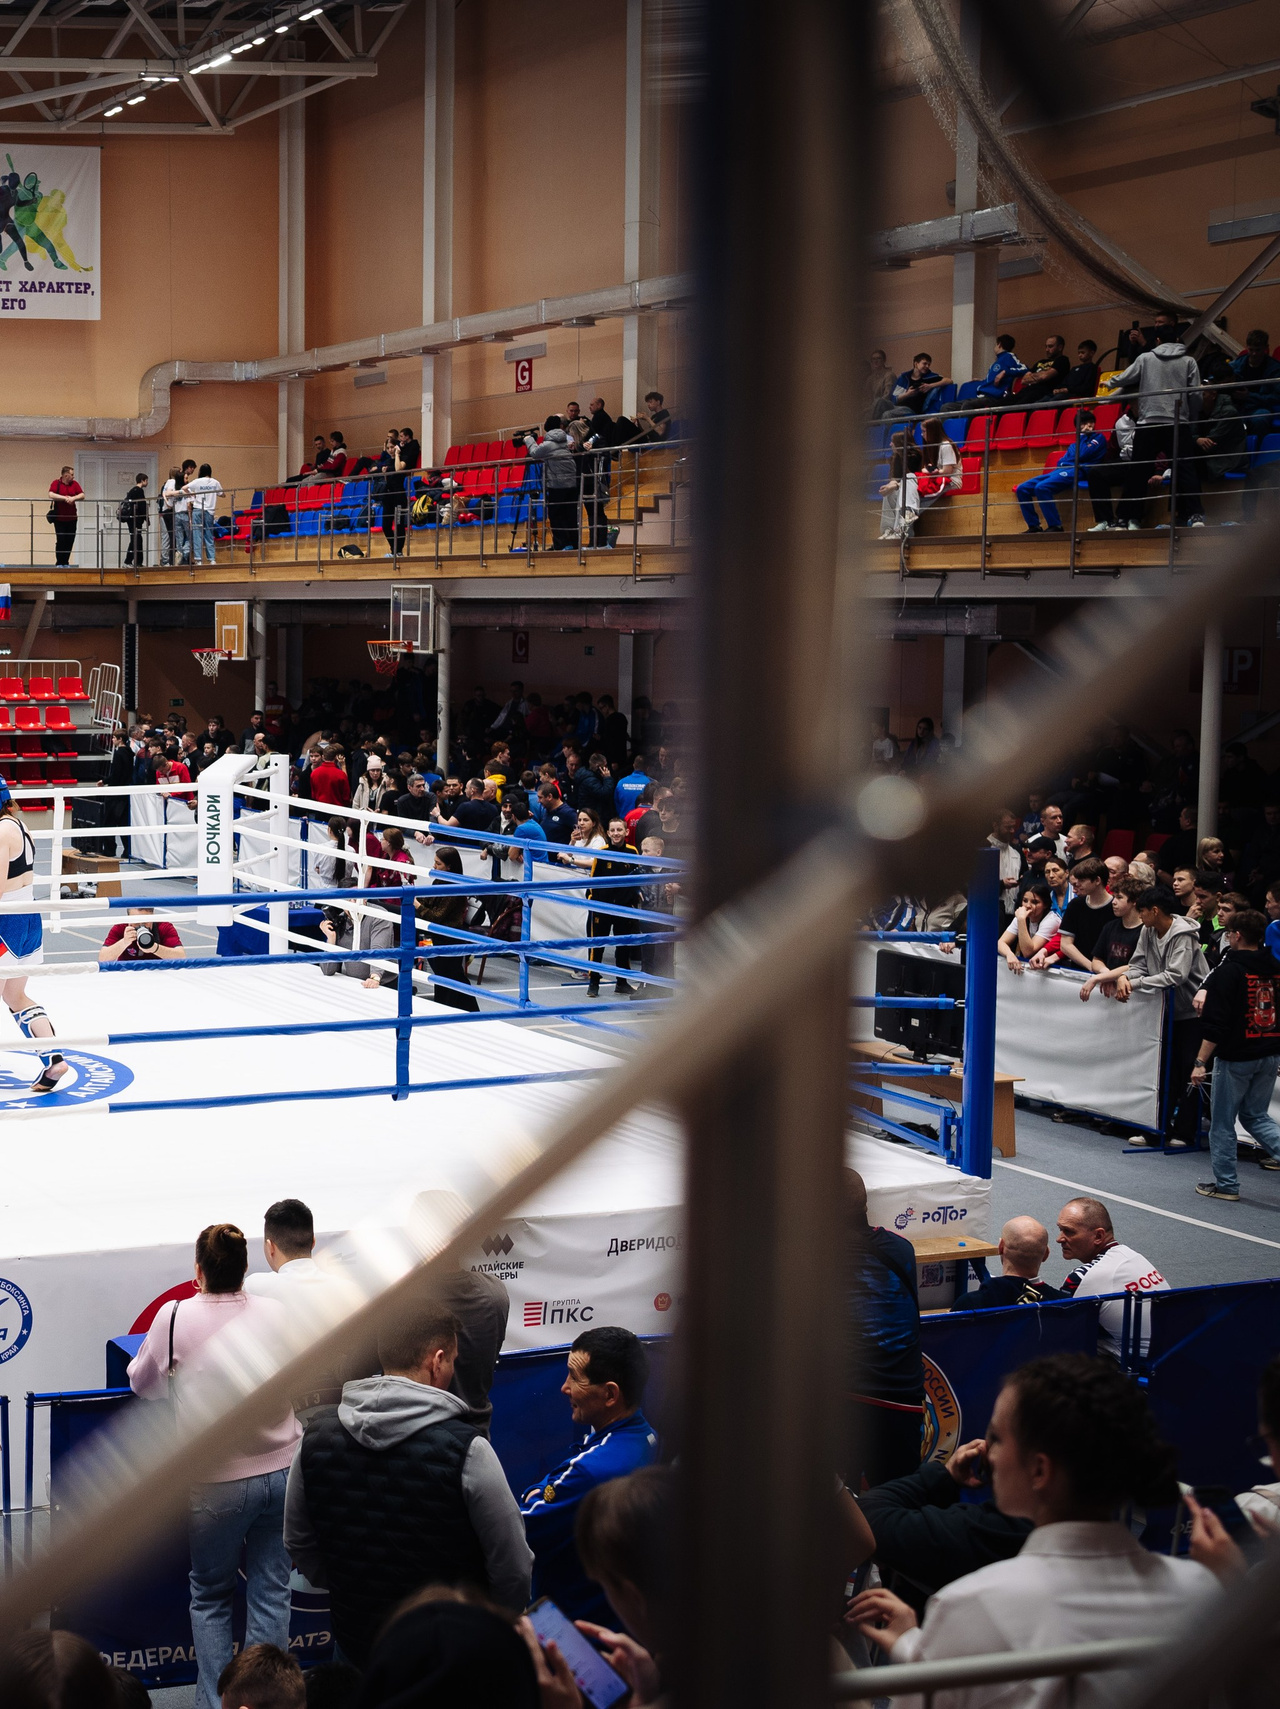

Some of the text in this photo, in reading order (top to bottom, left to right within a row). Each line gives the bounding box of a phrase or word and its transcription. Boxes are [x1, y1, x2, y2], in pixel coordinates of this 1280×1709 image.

[18, 281, 95, 296] ХАРАКТЕР,
[1, 298, 27, 310] ЕГО
[517, 360, 530, 385] G
[1223, 648, 1254, 683] IP
[206, 794, 221, 864] БОЧКАРИ
[471, 1260, 525, 1273] АЛТАЙСКИЕ
[494, 1271, 518, 1281] ЬЕРЫ
[552, 1298, 581, 1306] ГРУППА
[551, 1306, 594, 1325] ПКС
[1, 1344, 19, 1361] КРАЙ
